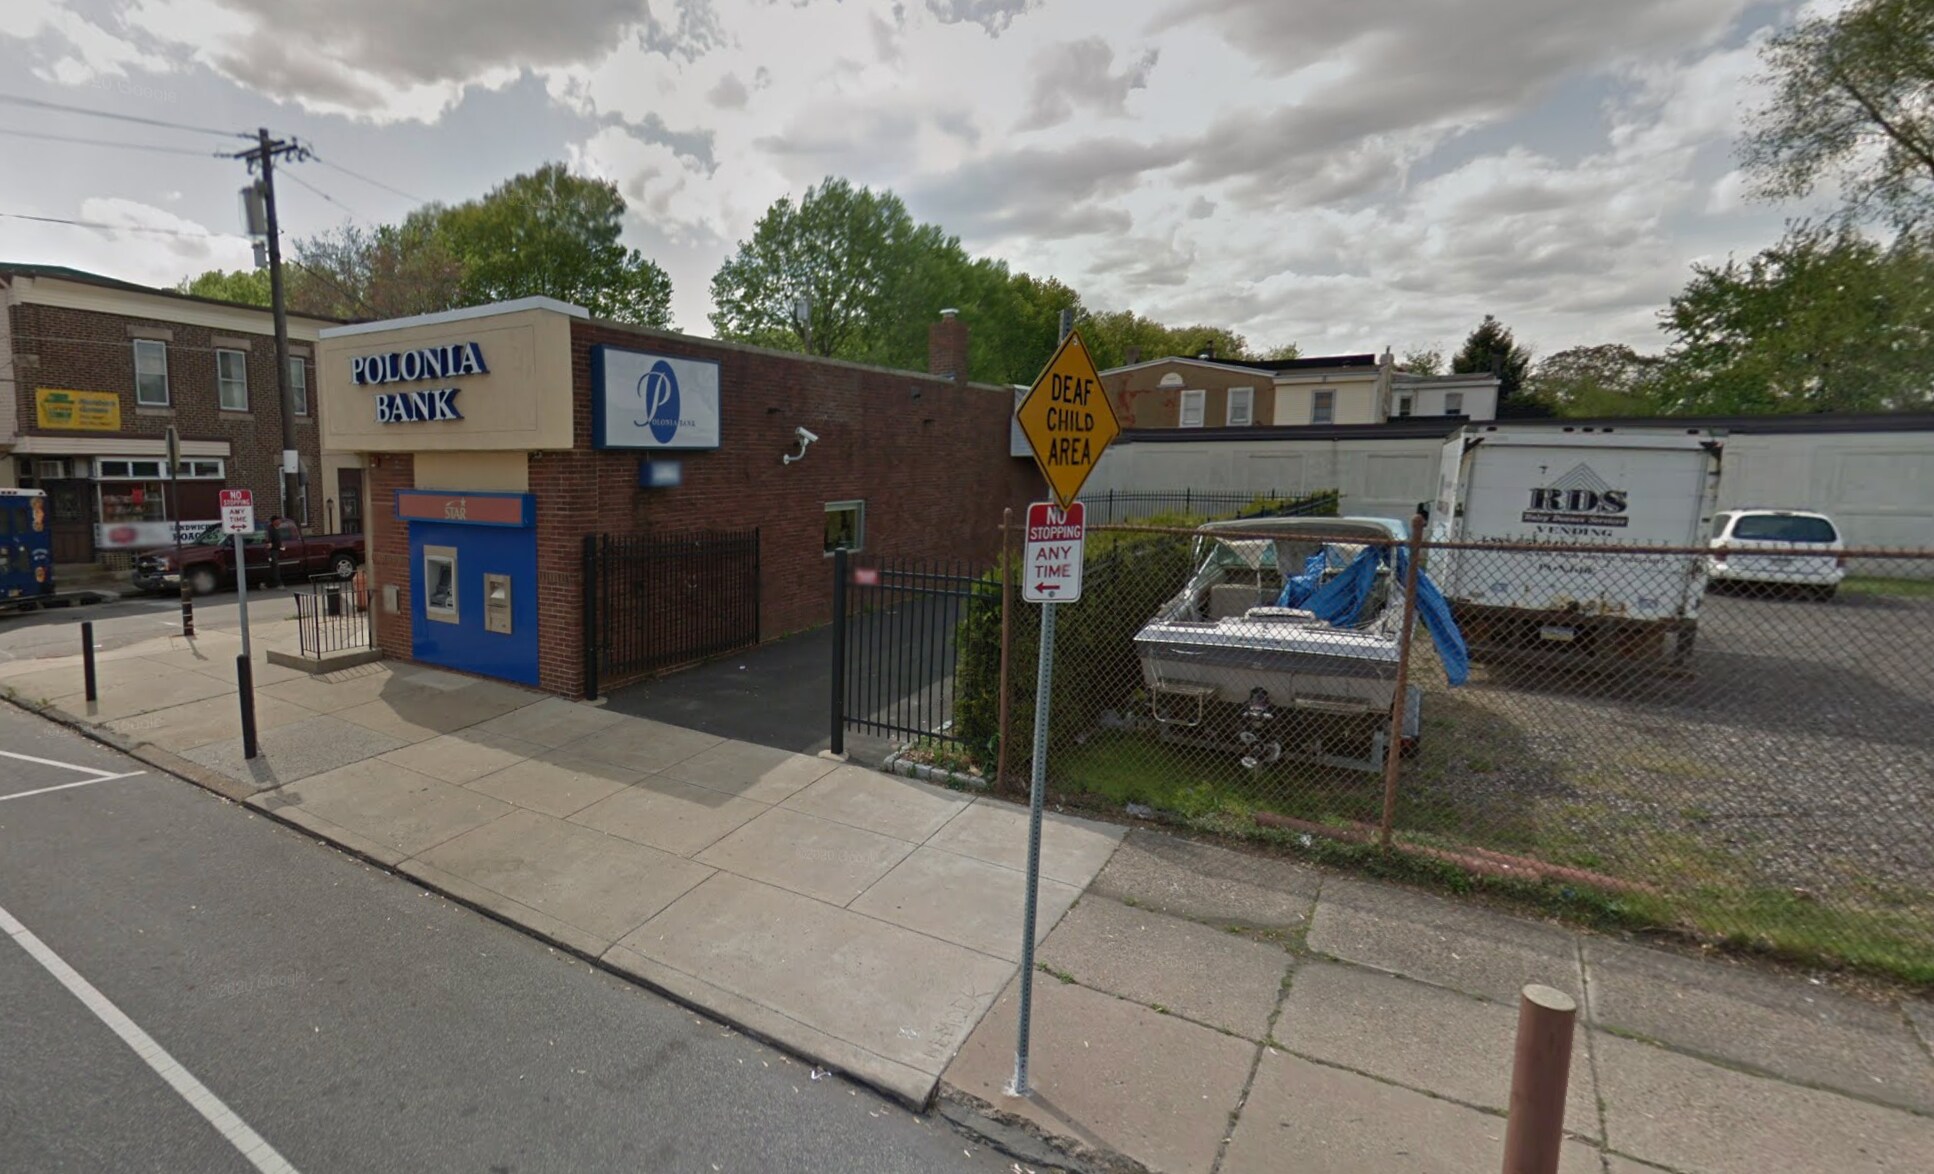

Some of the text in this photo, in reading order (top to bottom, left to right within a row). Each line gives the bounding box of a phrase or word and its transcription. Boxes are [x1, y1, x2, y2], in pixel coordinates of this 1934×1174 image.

[350, 341, 490, 386] POLONIA
[1051, 373, 1094, 406] DEAF
[374, 388, 464, 424] BANK
[1047, 407, 1094, 432] CHILD
[1048, 438, 1091, 466] AREA
[230, 491, 242, 499] NO
[1529, 488, 1629, 514] RDS
[444, 506, 467, 520] STAR
[1046, 506, 1067, 525] NO
[1029, 525, 1081, 540] STOPPING
[1537, 526, 1613, 537] VENDING
[1036, 546, 1072, 561] ANY
[1034, 564, 1071, 578] TIME
